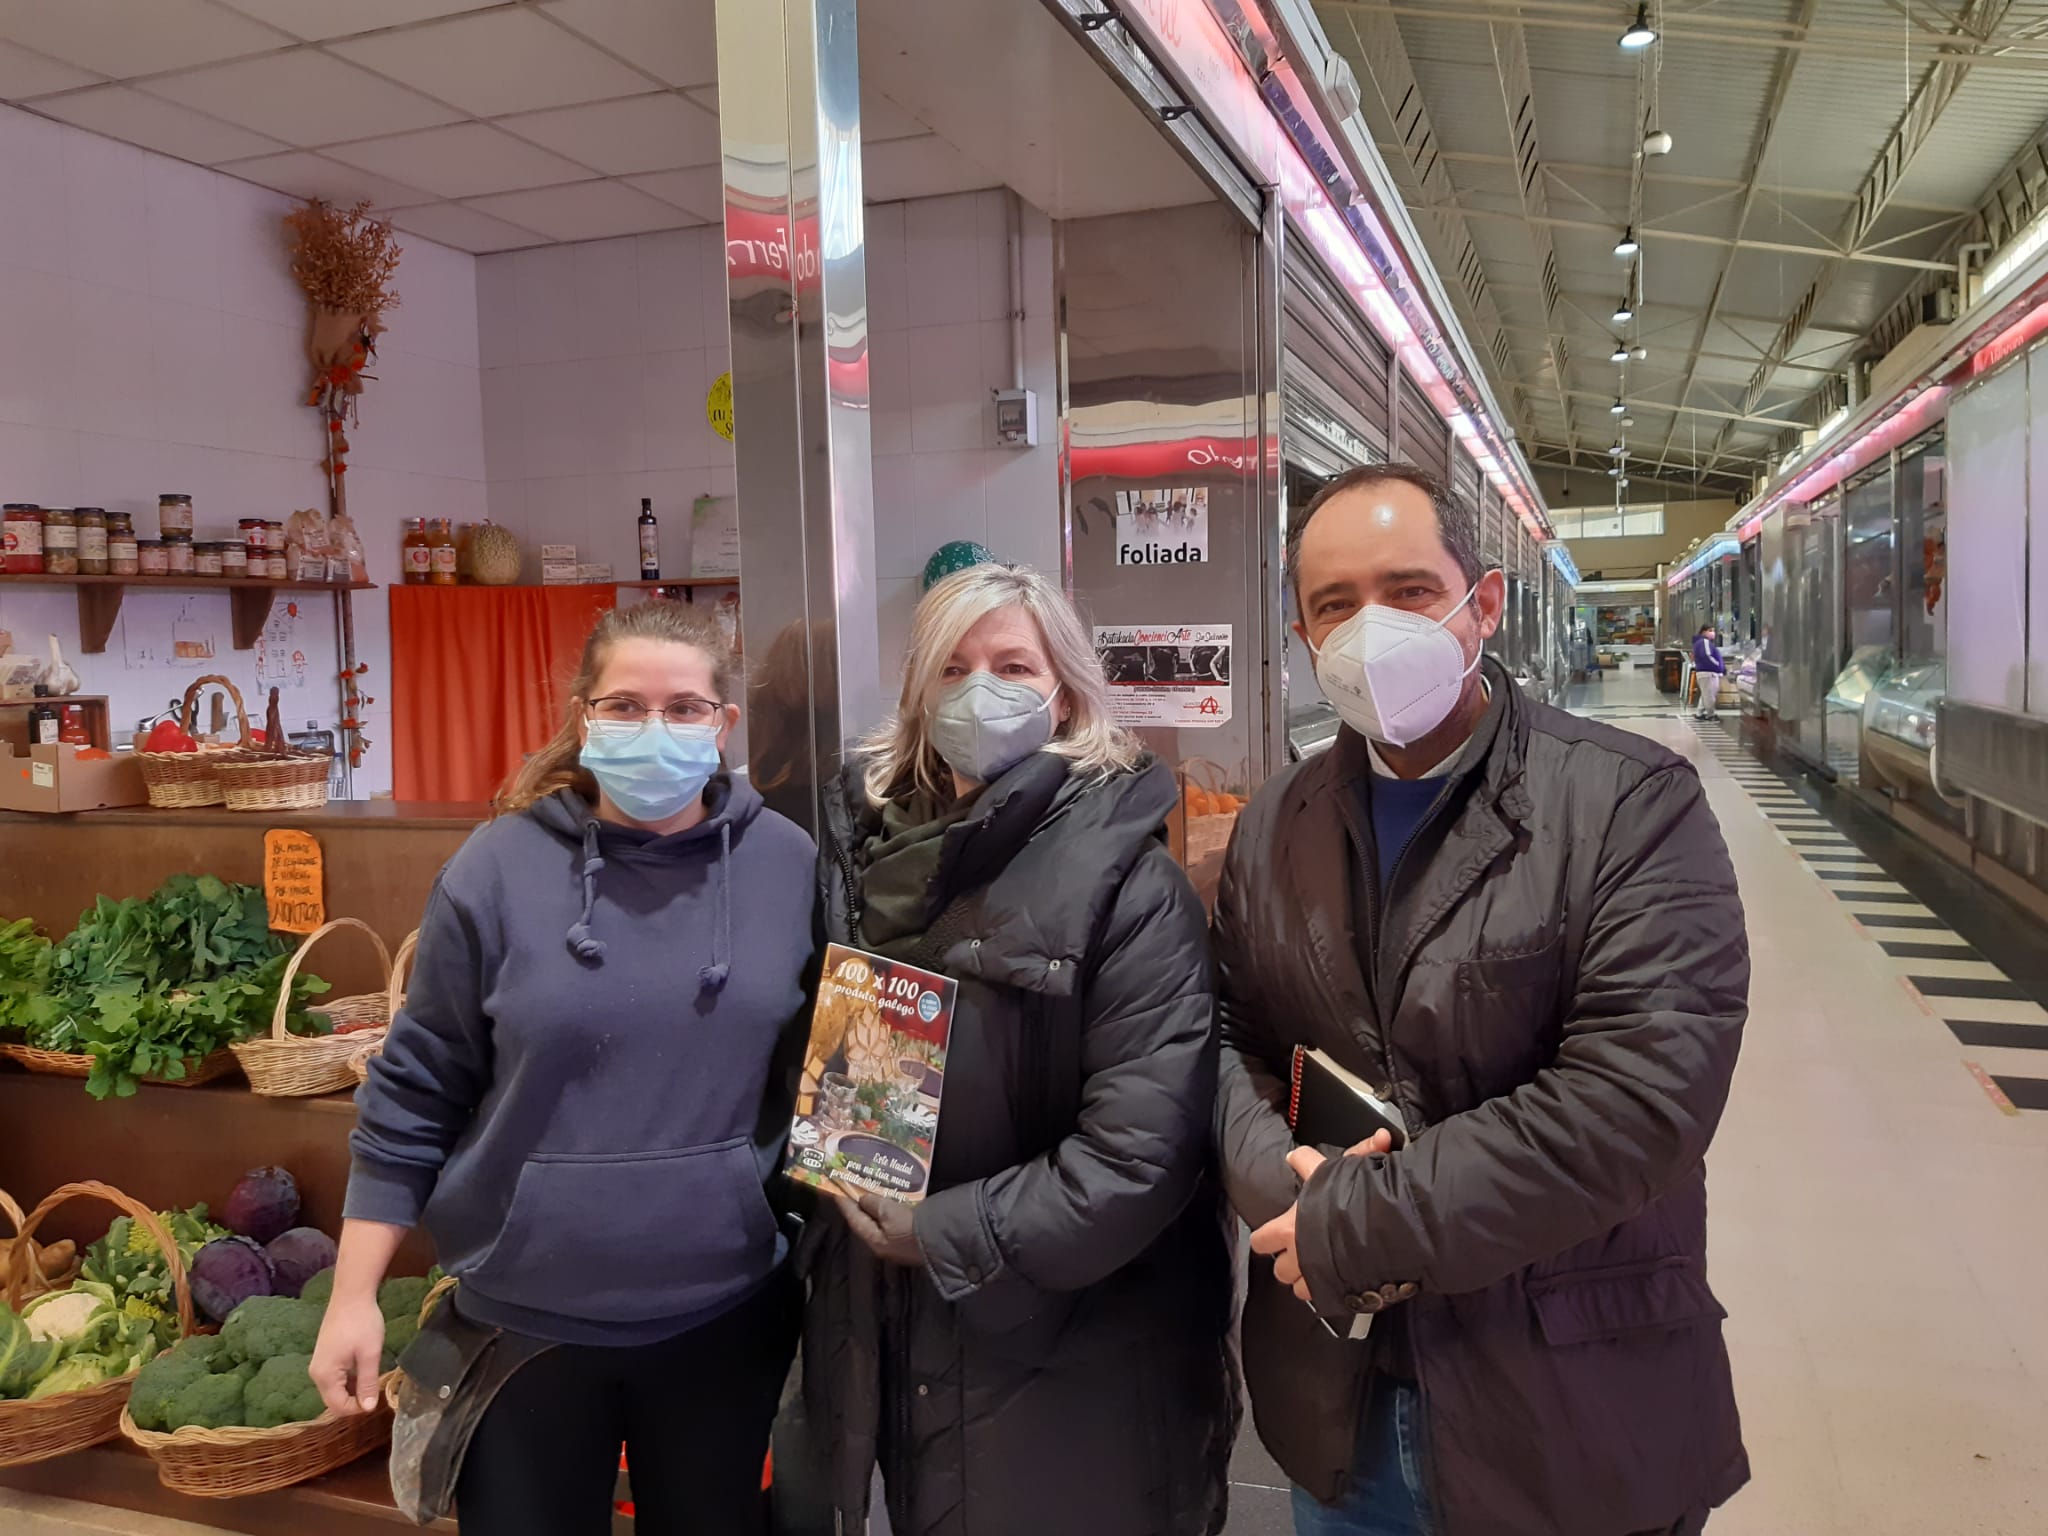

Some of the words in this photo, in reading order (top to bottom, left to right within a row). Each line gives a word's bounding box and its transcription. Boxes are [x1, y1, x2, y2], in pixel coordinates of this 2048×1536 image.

[1120, 542, 1202, 564] foliada
[837, 961, 868, 984] 100
[872, 975, 884, 990] x
[888, 976, 919, 1000] 100
[834, 984, 876, 1002] produto
[878, 997, 915, 1016] galego
[873, 1152, 888, 1166] Este
[890, 1158, 914, 1175] Nadal
[829, 1169, 861, 1184] produto
